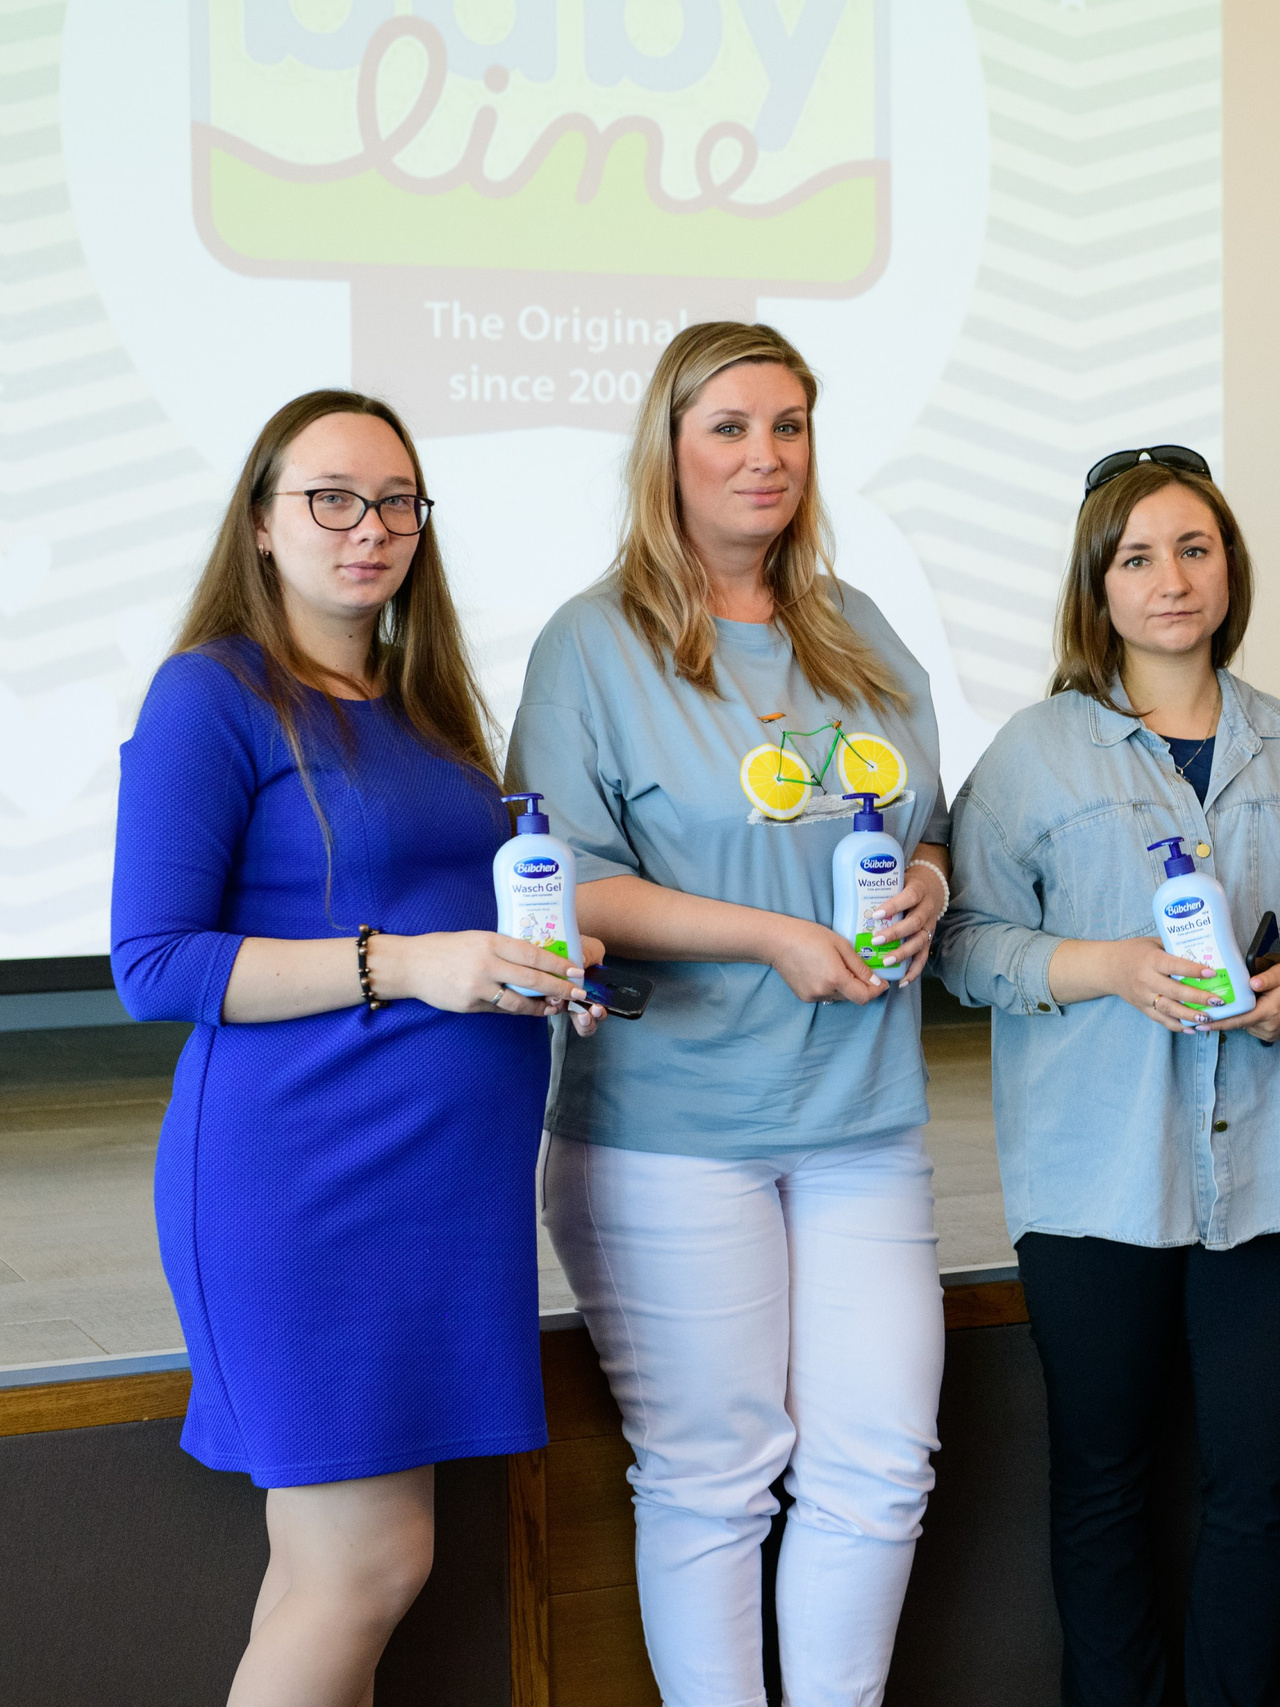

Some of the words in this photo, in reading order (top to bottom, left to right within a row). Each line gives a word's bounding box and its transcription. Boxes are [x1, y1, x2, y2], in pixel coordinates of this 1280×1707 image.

[355, 14, 765, 220] line
[423, 300, 505, 341] The
[517, 304, 688, 353] Original
[449, 362, 556, 403] since
[568, 368, 653, 405] 200
[516, 862, 557, 874] Bübchen
[862, 858, 896, 869] Bübchen
[511, 883, 544, 894] Wasch
[545, 882, 562, 892] Gel
[857, 877, 886, 887] Wasch
[886, 877, 899, 887] Gel
[1166, 900, 1202, 916] Bübchen
[1166, 921, 1195, 934] Wasch
[1195, 916, 1211, 927] Gel
